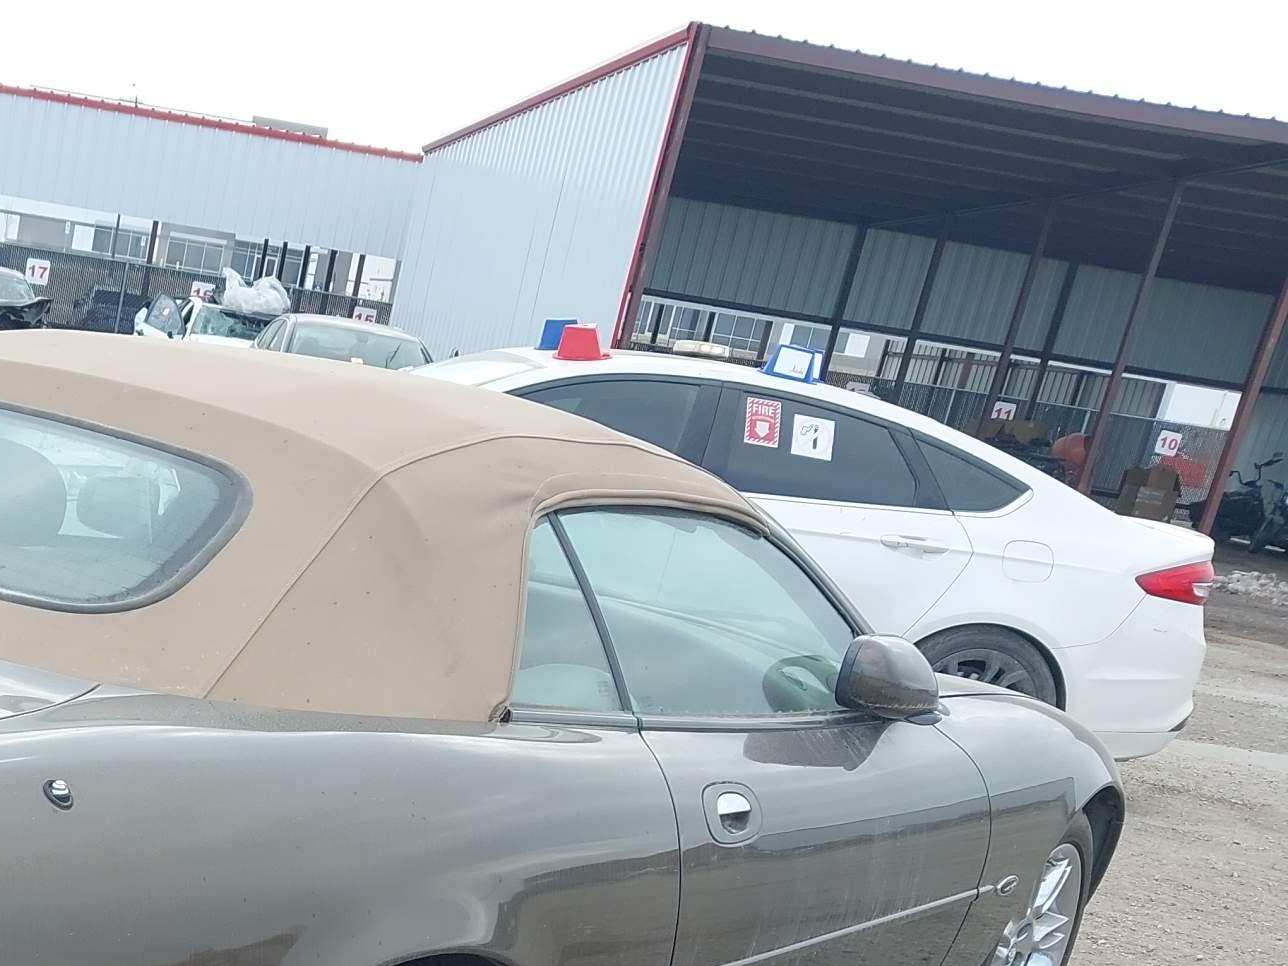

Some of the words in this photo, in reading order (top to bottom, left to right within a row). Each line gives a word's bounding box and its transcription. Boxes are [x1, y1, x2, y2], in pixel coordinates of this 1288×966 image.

[28, 264, 49, 280] 17
[753, 403, 775, 417] FIRE
[994, 407, 1012, 420] 11
[1161, 436, 1178, 451] 10
